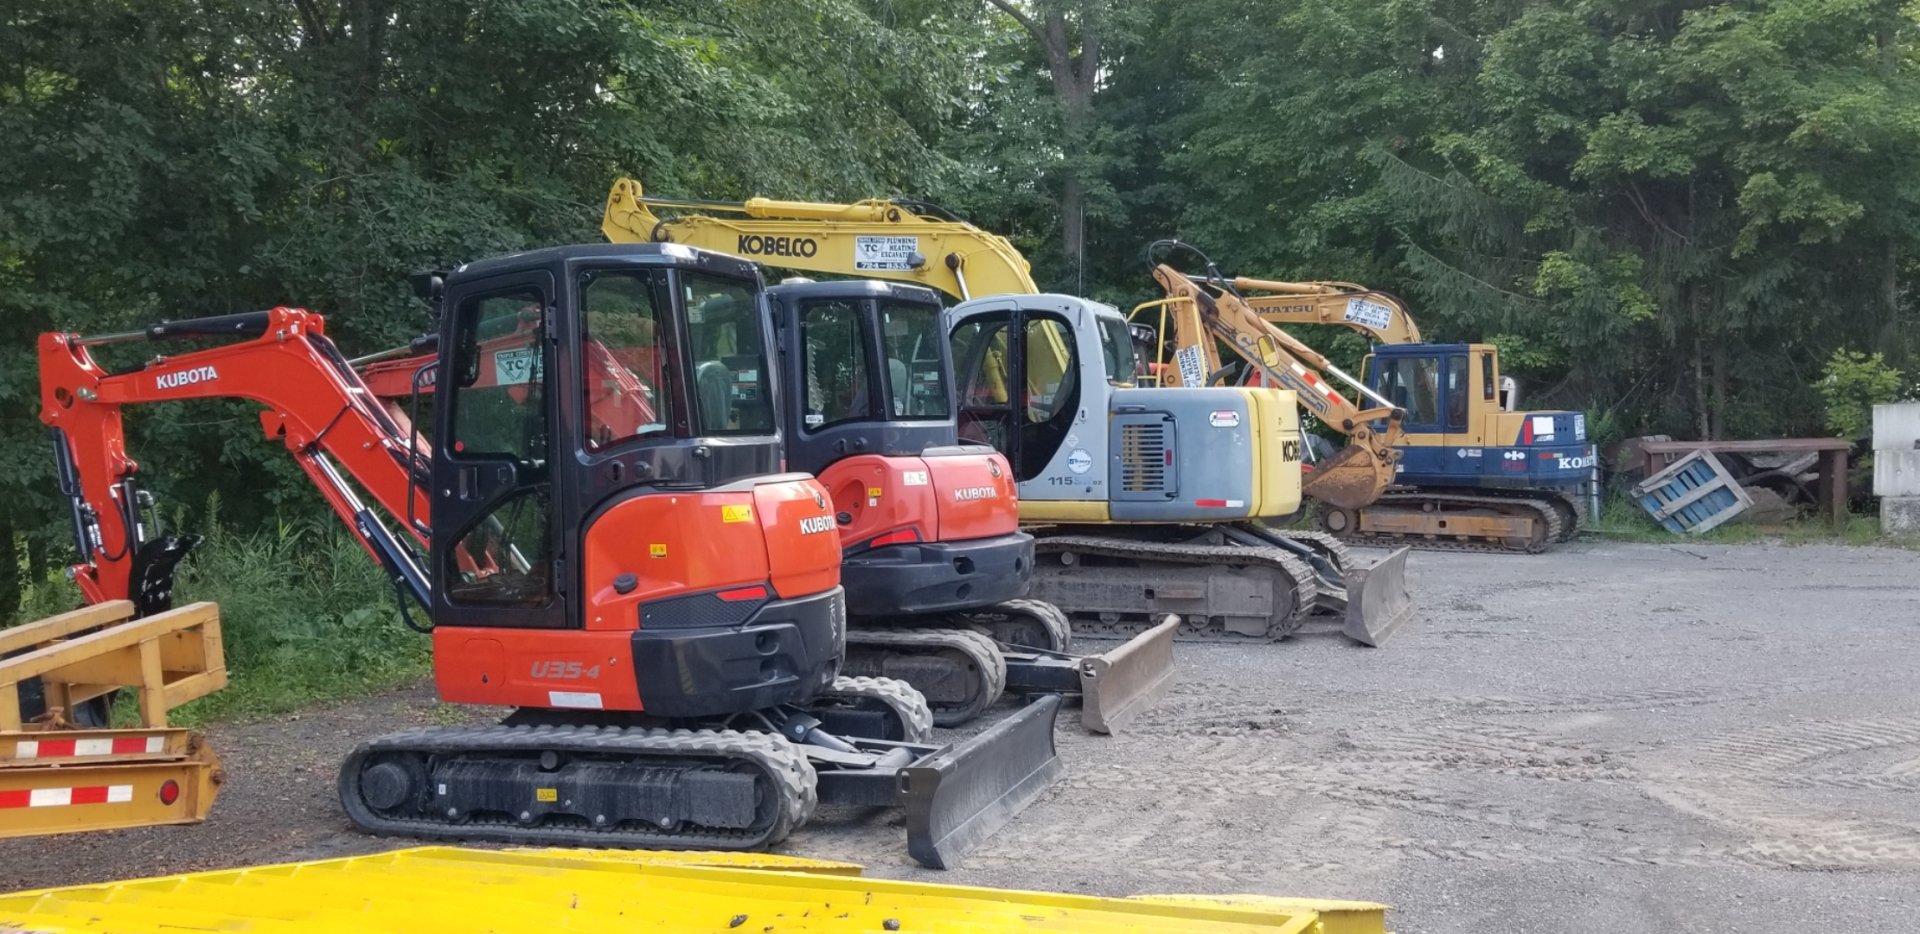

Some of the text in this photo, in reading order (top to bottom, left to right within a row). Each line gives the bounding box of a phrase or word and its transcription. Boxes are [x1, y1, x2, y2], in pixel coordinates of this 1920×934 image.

[738, 235, 817, 258] KOBELCO
[864, 244, 878, 252] TC
[506, 360, 523, 371] TC
[156, 366, 218, 390] KUBOTA
[954, 486, 997, 501] KUBOTA
[800, 516, 836, 534] KUBOTA
[531, 661, 600, 679] U35-4
